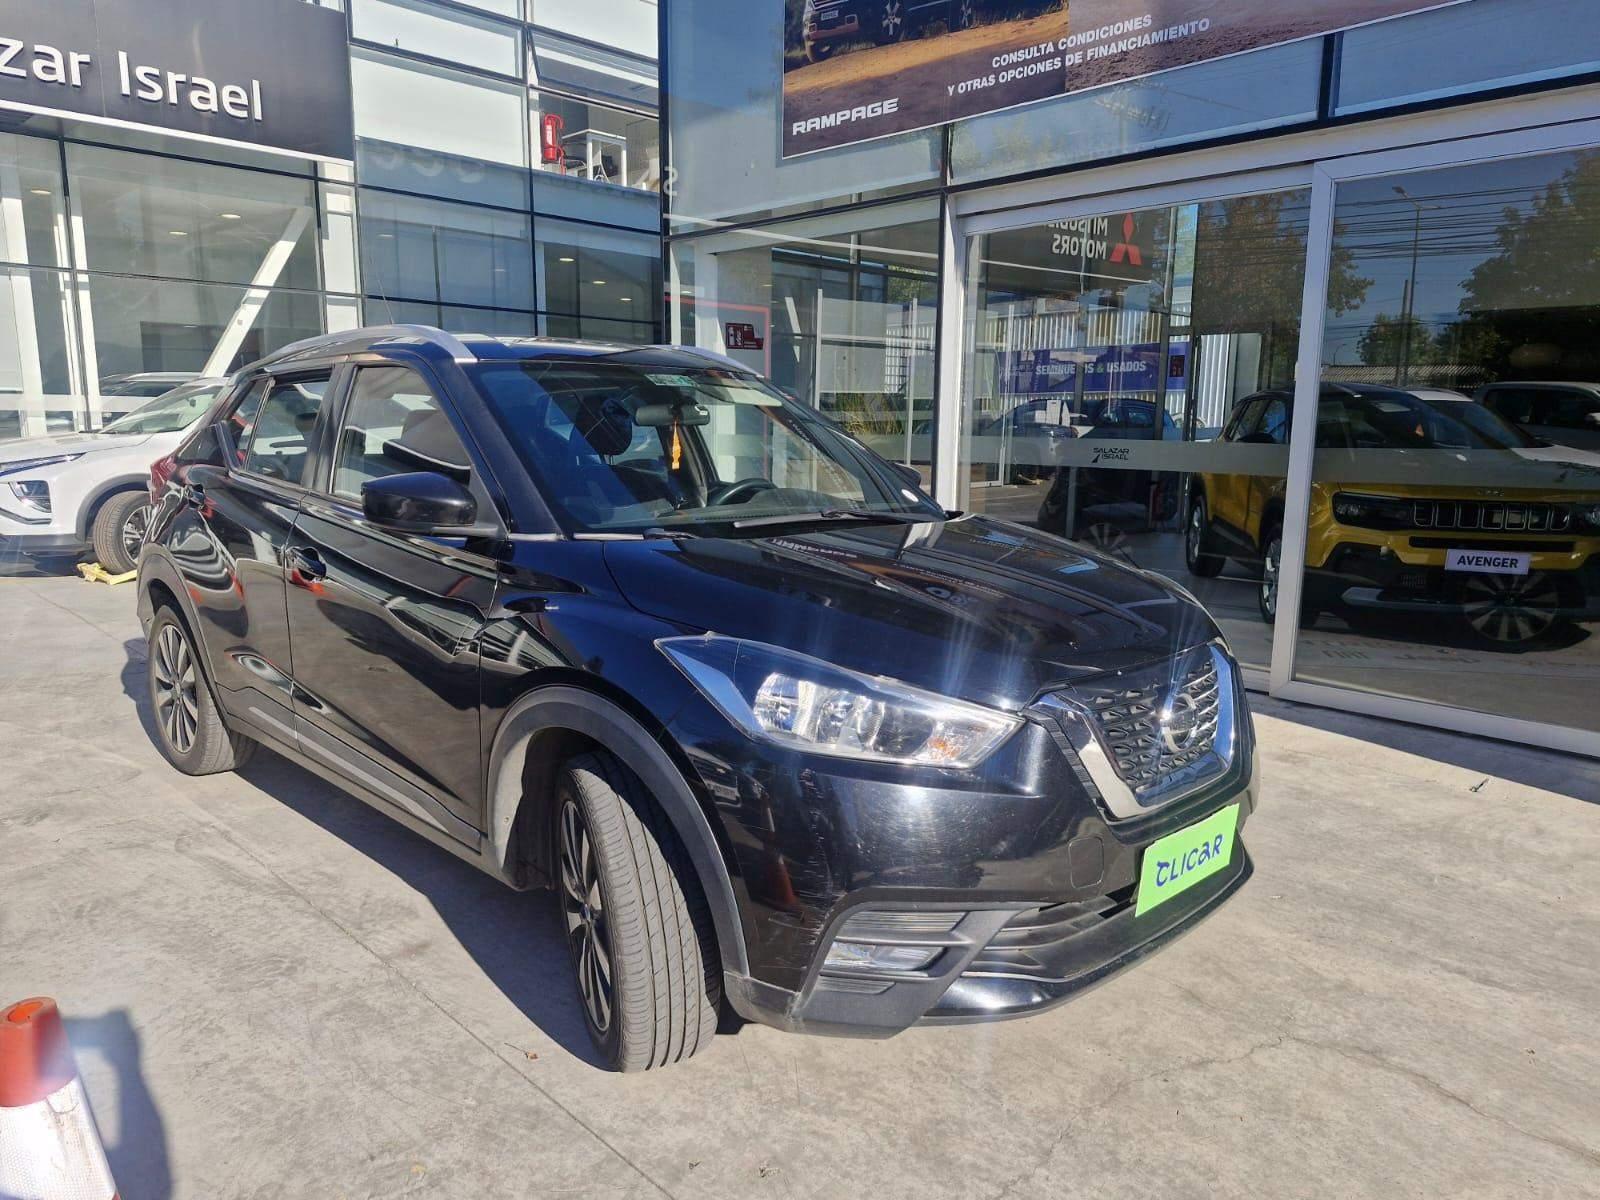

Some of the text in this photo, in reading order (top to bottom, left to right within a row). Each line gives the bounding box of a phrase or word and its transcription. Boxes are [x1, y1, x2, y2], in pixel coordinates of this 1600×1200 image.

[947, 18, 1211, 97] Y OTRAS OPCIONES DE FINANCIAMIENTO
[992, 14, 1153, 68] CONSULTA CONDICIONES
[118, 50, 263, 121] Israel
[792, 98, 899, 136] RAMPAGE
[1106, 360, 1147, 373] USADOS
[1457, 555, 1519, 569] AVENGER
